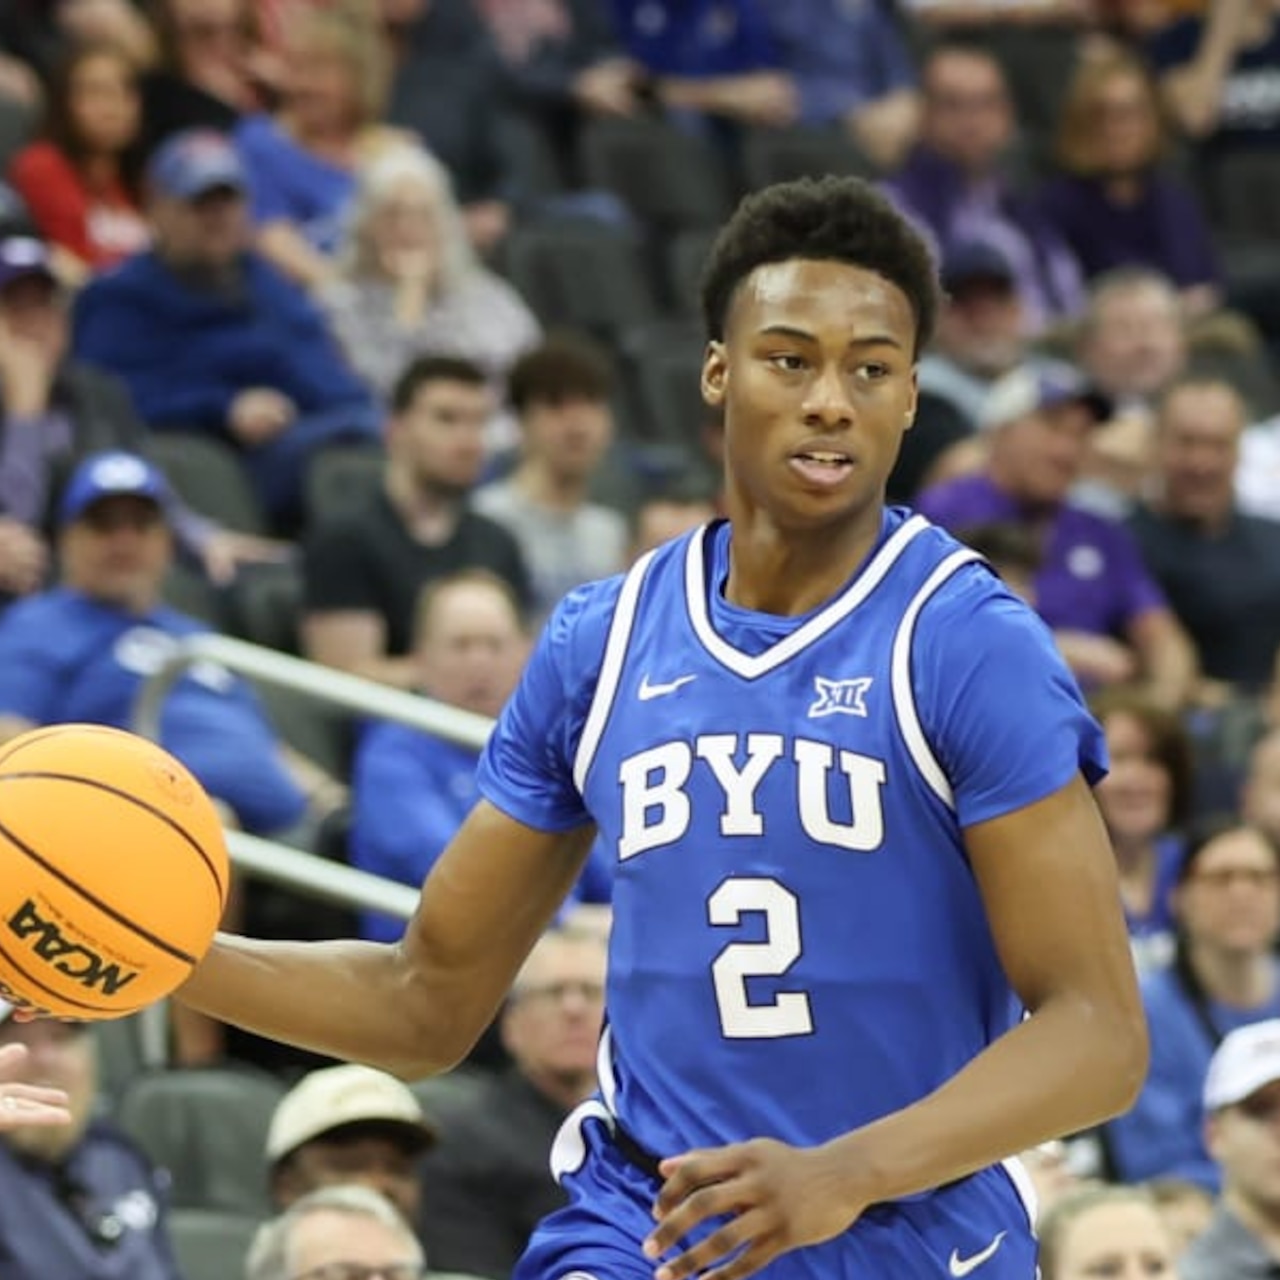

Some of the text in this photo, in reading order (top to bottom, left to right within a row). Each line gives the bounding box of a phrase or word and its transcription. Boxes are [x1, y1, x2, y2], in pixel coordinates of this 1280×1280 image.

[618, 732, 887, 864] BYU
[5, 897, 138, 996] NCAA
[706, 875, 815, 1040] 2
